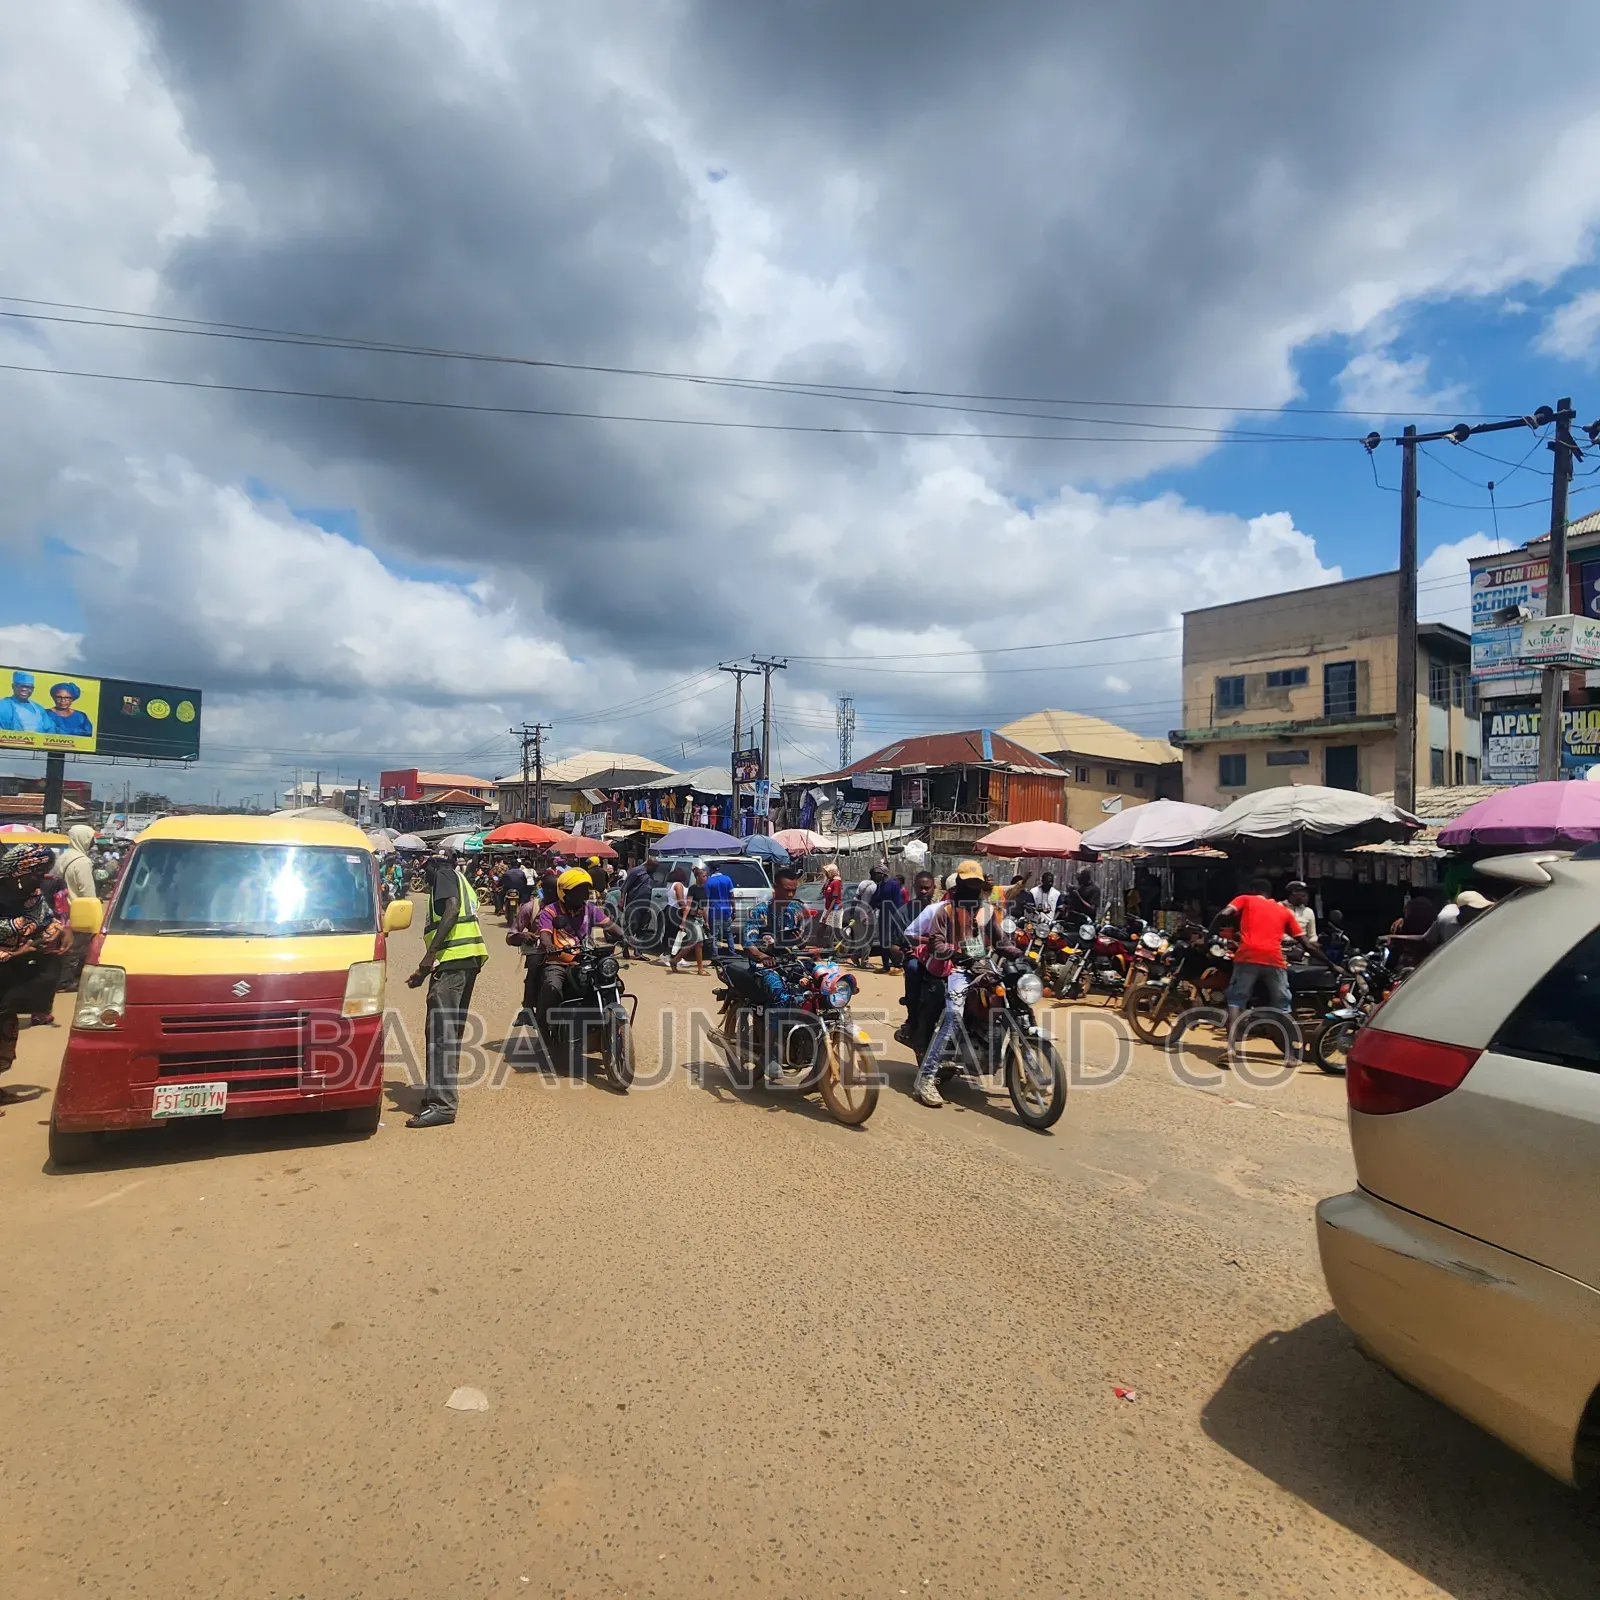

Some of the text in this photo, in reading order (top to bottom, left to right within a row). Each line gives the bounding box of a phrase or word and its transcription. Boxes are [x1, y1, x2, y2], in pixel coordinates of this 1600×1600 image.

[1495, 571, 1503, 585] U
[1504, 567, 1525, 582] CAN
[1571, 744, 1596, 755] WAIT
